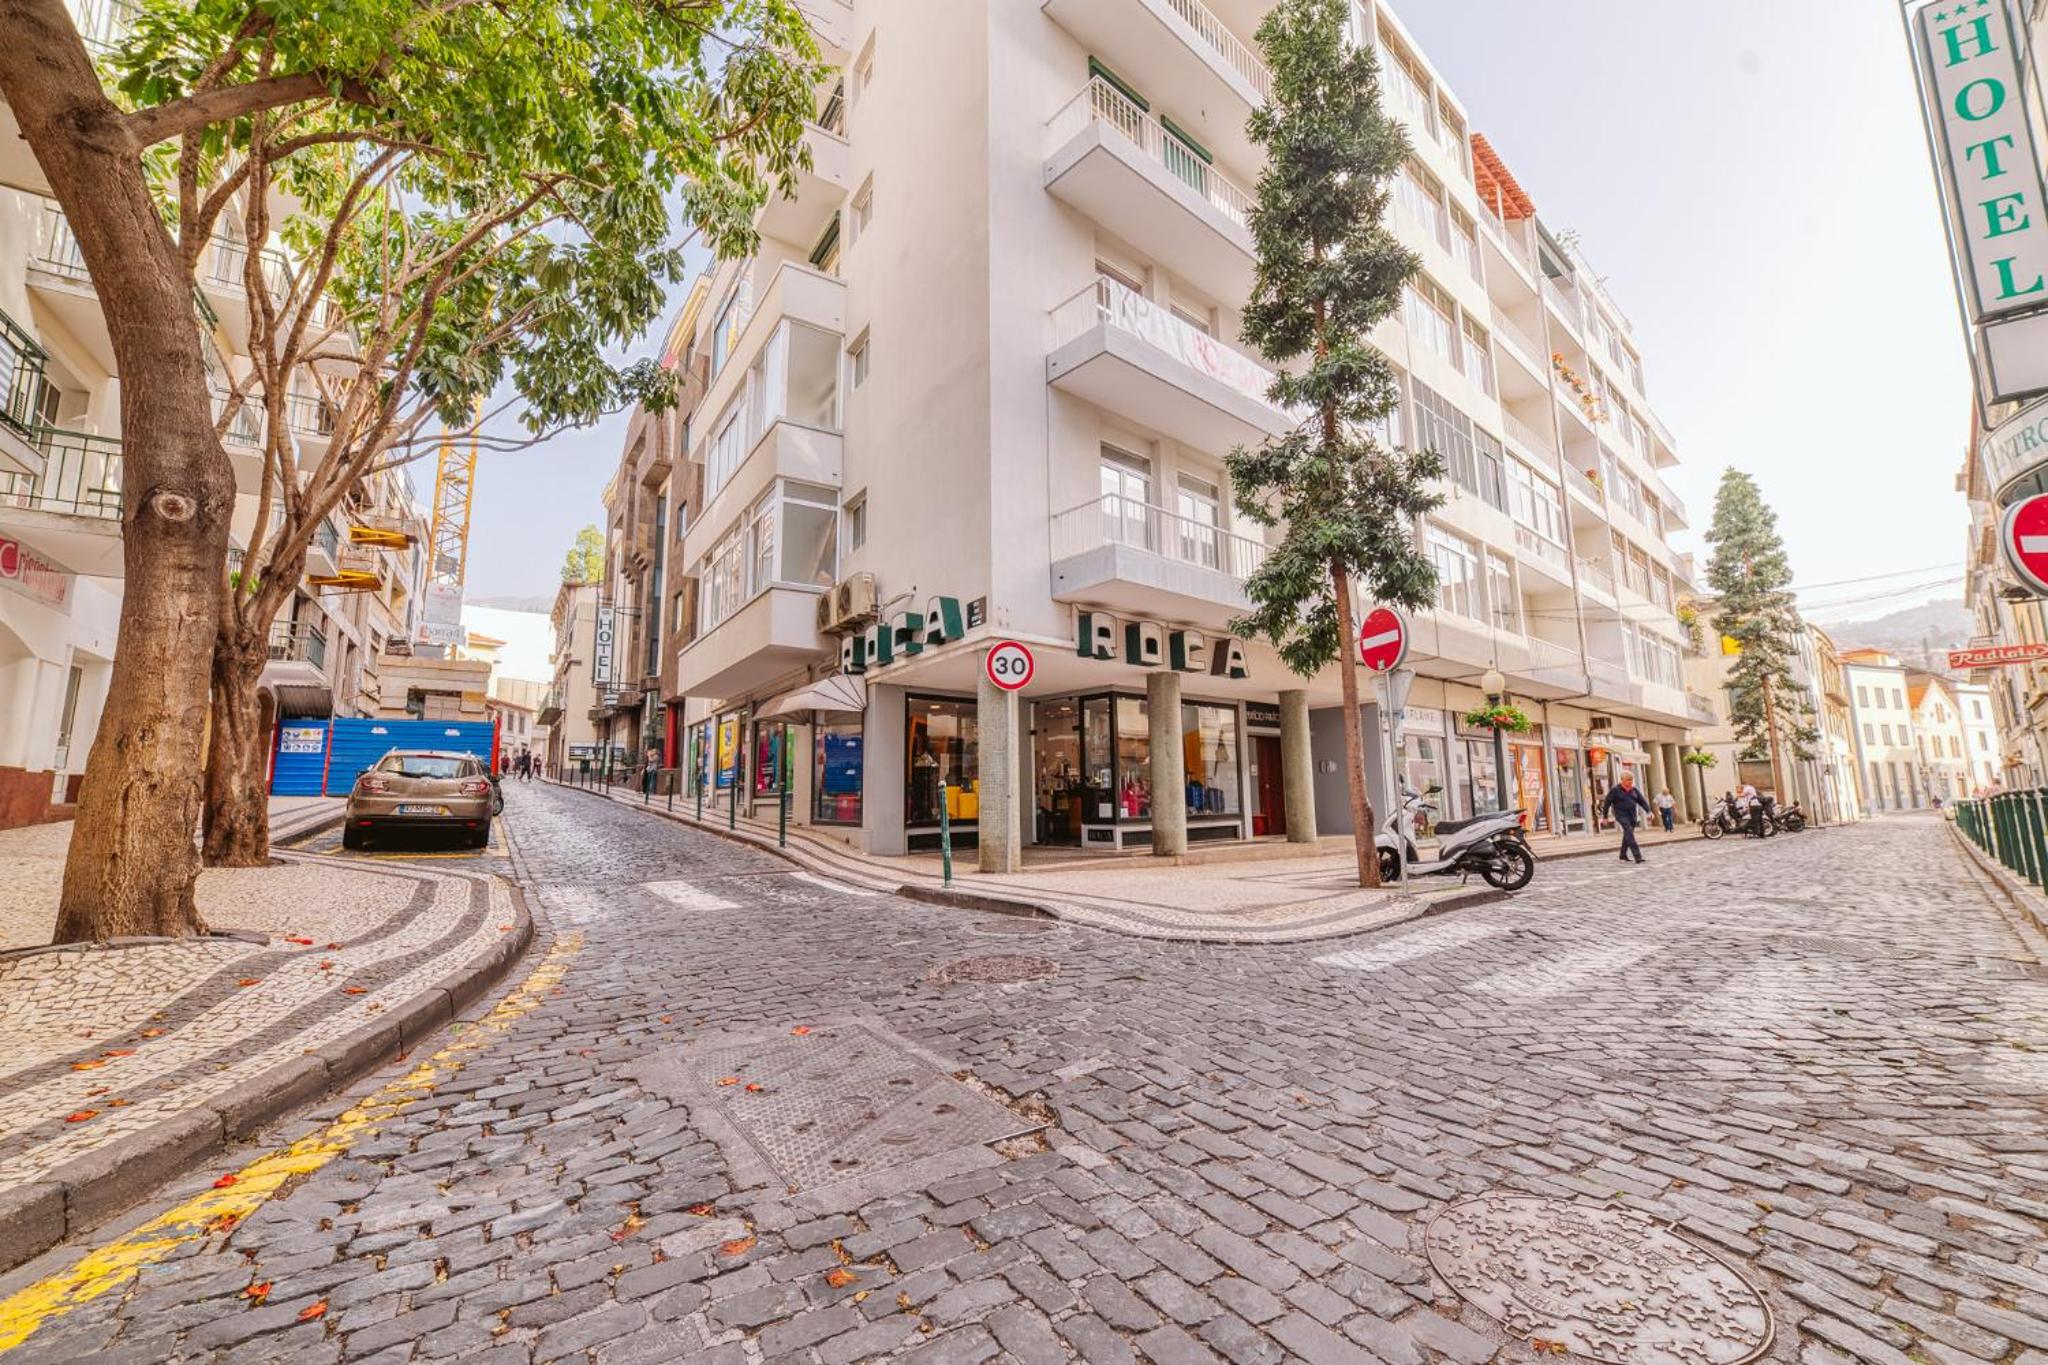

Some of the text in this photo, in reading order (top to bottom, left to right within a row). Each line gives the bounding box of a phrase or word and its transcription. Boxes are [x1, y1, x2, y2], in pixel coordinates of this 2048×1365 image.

[1937, 13, 2045, 301] HOTEL
[597, 617, 613, 680] HOTEL
[842, 595, 965, 676] ROCA
[994, 656, 1027, 676] 30
[1078, 611, 1250, 679] ROCA
